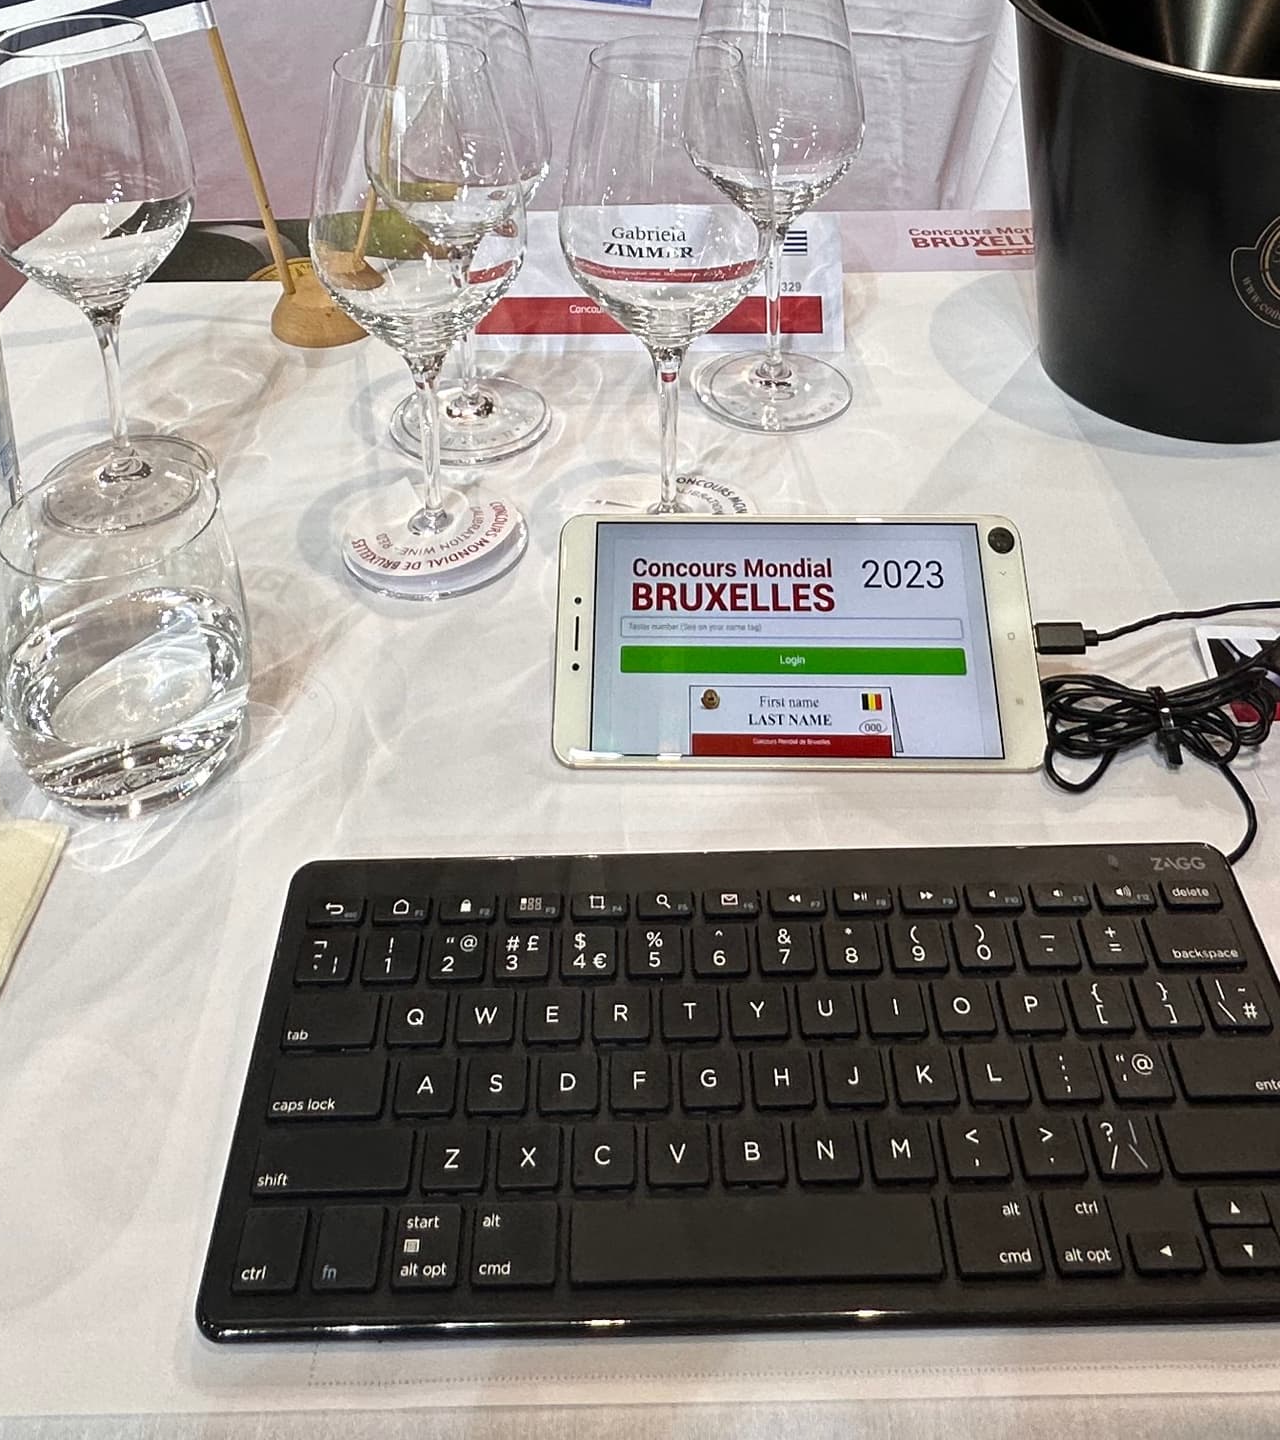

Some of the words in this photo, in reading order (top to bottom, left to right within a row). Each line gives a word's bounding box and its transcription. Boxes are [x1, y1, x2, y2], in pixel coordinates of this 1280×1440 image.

[908, 227, 992, 237] Concours
[910, 236, 1034, 249] BRUXELL
[568, 304, 607, 315] Concou
[676, 476, 734, 500] ONCOURS
[487, 501, 509, 538] CONCOURS
[352, 538, 401, 570] BRUXELLES
[429, 537, 490, 570] MONDIAL
[402, 561, 421, 571] DE
[632, 557, 737, 578] Concours
[744, 557, 833, 578] Mondial
[861, 559, 945, 589] 2023
[631, 582, 836, 612] BRUXELLES
[779, 654, 806, 667] Login
[759, 695, 785, 708] First
[788, 697, 820, 709] name
[748, 713, 785, 726] LAST
[788, 713, 833, 726] NAME
[864, 722, 882, 732] 000
[1150, 856, 1206, 871] ZAGG
[1171, 887, 1209, 897] delete
[1172, 948, 1239, 960] backspace
[683, 1002, 697, 1020] T
[749, 1001, 765, 1018] Y
[817, 999, 833, 1017] U
[892, 998, 899, 1016] I
[953, 996, 971, 1015] O
[1023, 995, 1038, 1013] P
[406, 1008, 425, 1026] Q
[474, 1006, 498, 1025] W
[546, 1005, 559, 1023] E
[614, 1004, 628, 1022] R
[287, 1029, 309, 1041] tab
[272, 1101, 304, 1113] caps
[307, 1097, 336, 1111] lock
[257, 1172, 288, 1187] shift
[1002, 1202, 1021, 1216] alt
[1075, 1200, 1099, 1215] ctrl
[407, 1215, 440, 1229] start
[482, 1213, 501, 1228] alt
[999, 1248, 1032, 1264] cmd
[1065, 1248, 1084, 1262] alt
[1086, 1247, 1112, 1264] opt
[241, 1265, 267, 1281] ctrl
[322, 1264, 337, 1279] fn
[400, 1262, 418, 1277] alt
[422, 1262, 447, 1279] opt
[478, 1261, 511, 1275] cmd
